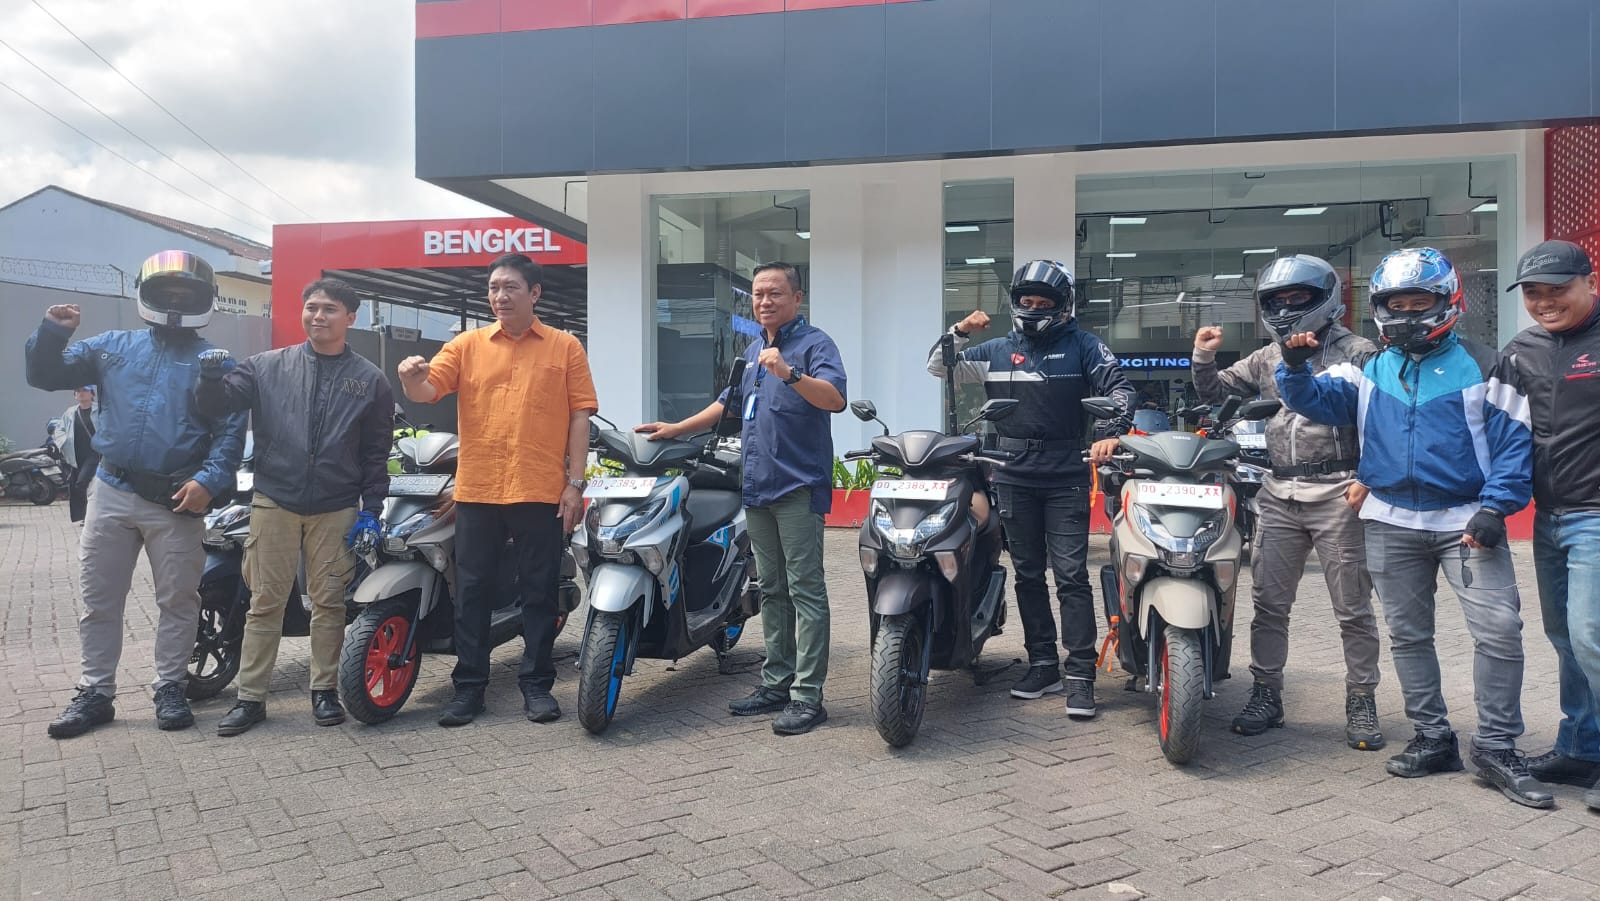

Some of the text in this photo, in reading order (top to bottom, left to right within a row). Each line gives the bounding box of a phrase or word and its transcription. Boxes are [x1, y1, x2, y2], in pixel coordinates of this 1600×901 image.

[424, 228, 562, 255] BENGKEL
[1118, 357, 1191, 367] XCITING
[876, 481, 890, 489] DD
[1141, 484, 1220, 497] DD 2390 XX
